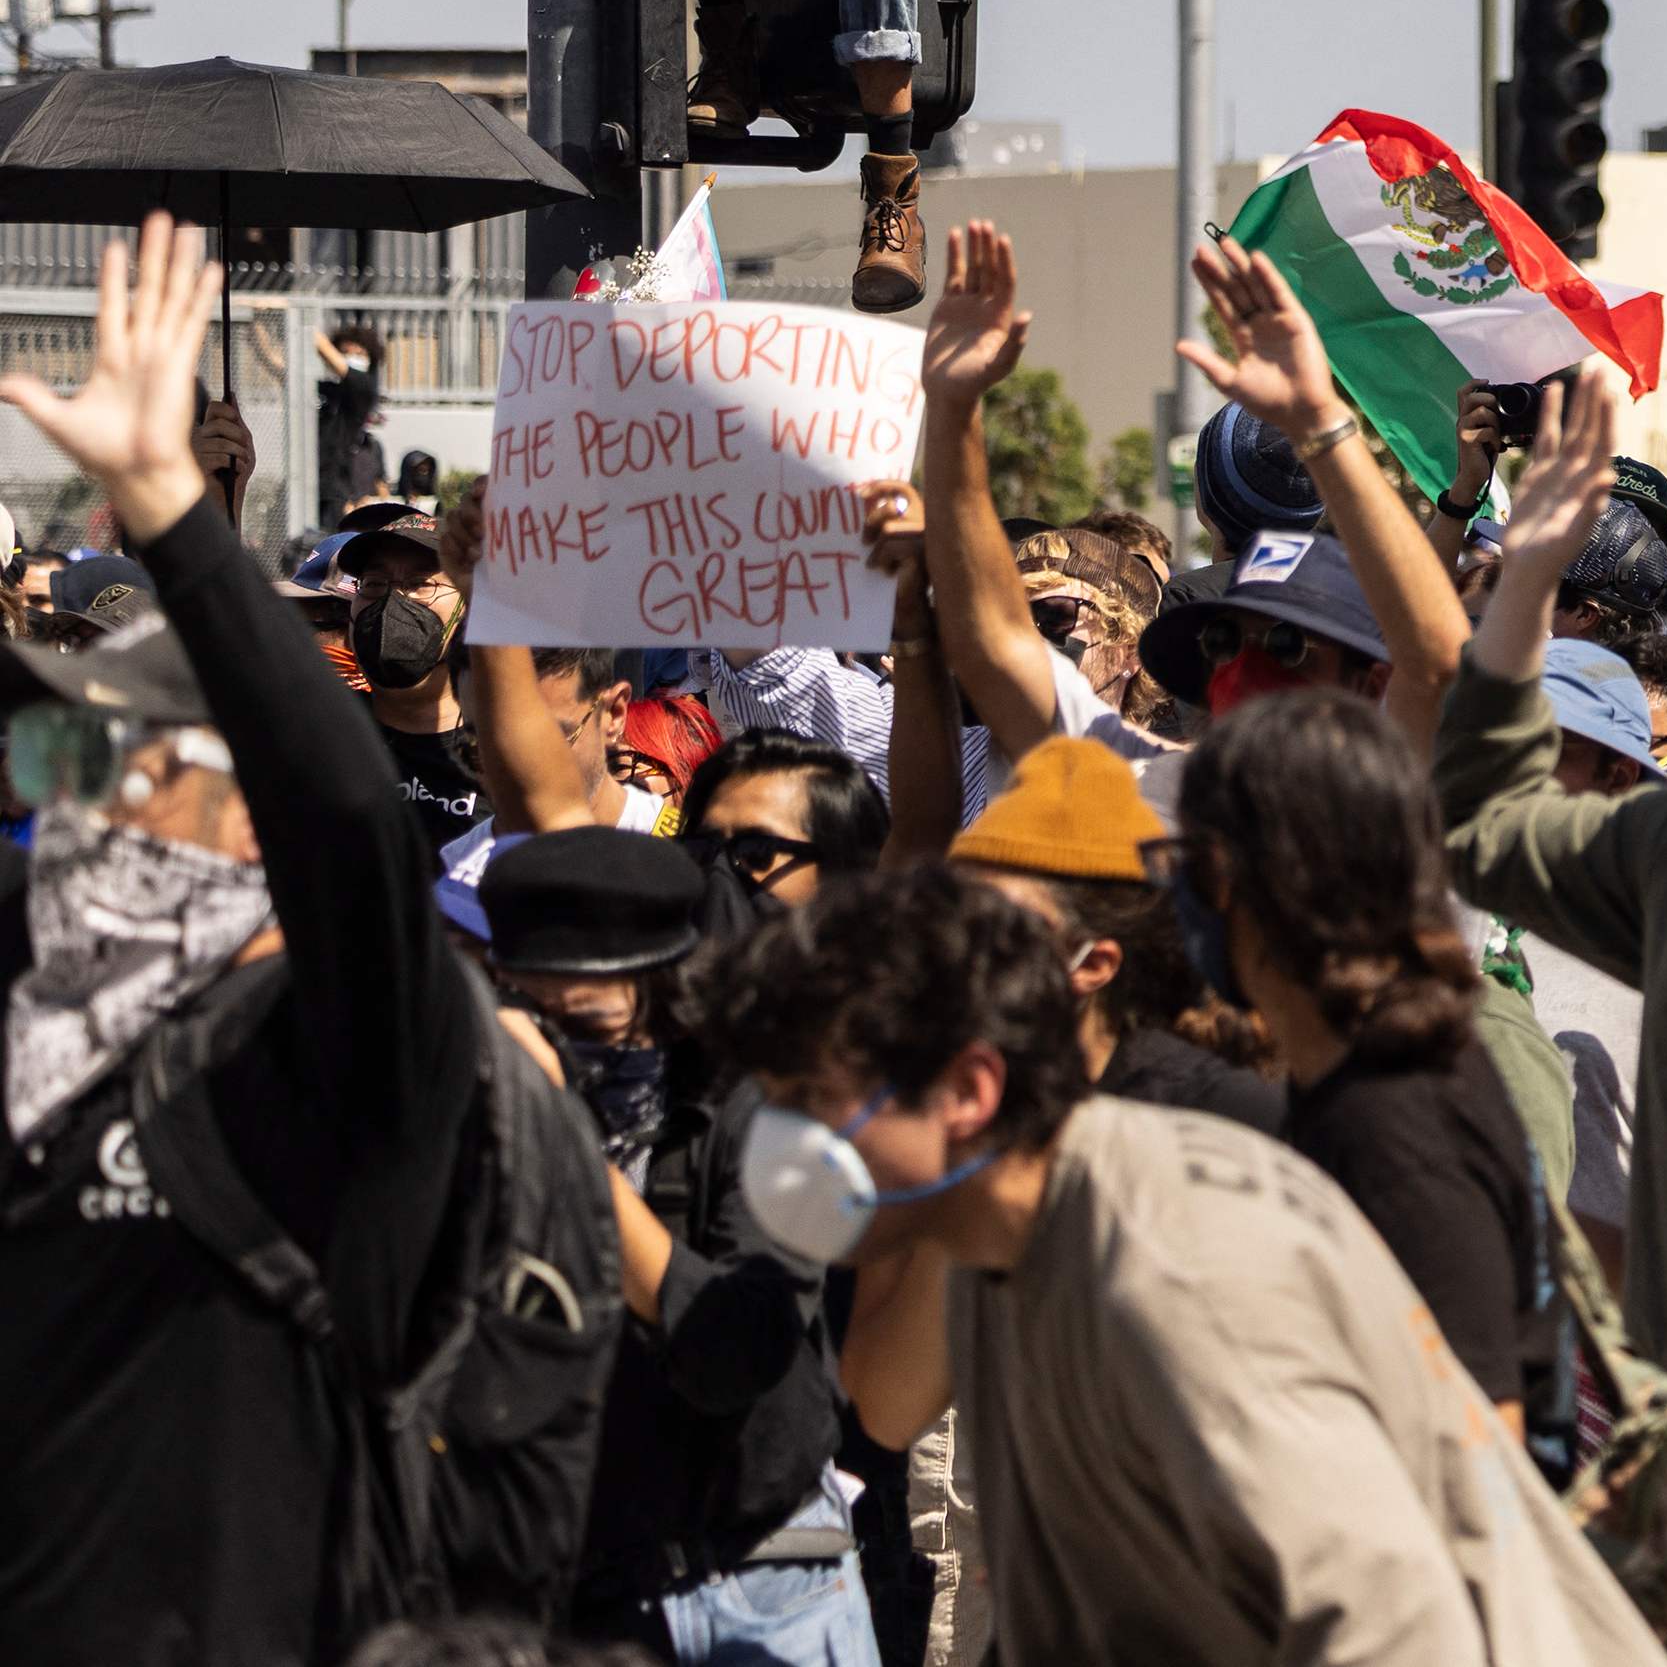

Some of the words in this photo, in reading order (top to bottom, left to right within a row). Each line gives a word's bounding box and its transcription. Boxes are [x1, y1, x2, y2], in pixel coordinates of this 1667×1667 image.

[502, 313, 595, 398] STOP
[606, 309, 920, 416] DEPORTING
[493, 418, 555, 488] THE
[574, 404, 747, 479] PEOPLE
[771, 407, 902, 460] WHO
[488, 501, 611, 576] MAKE
[625, 491, 741, 557] THIS
[640, 550, 859, 639] GREAT
